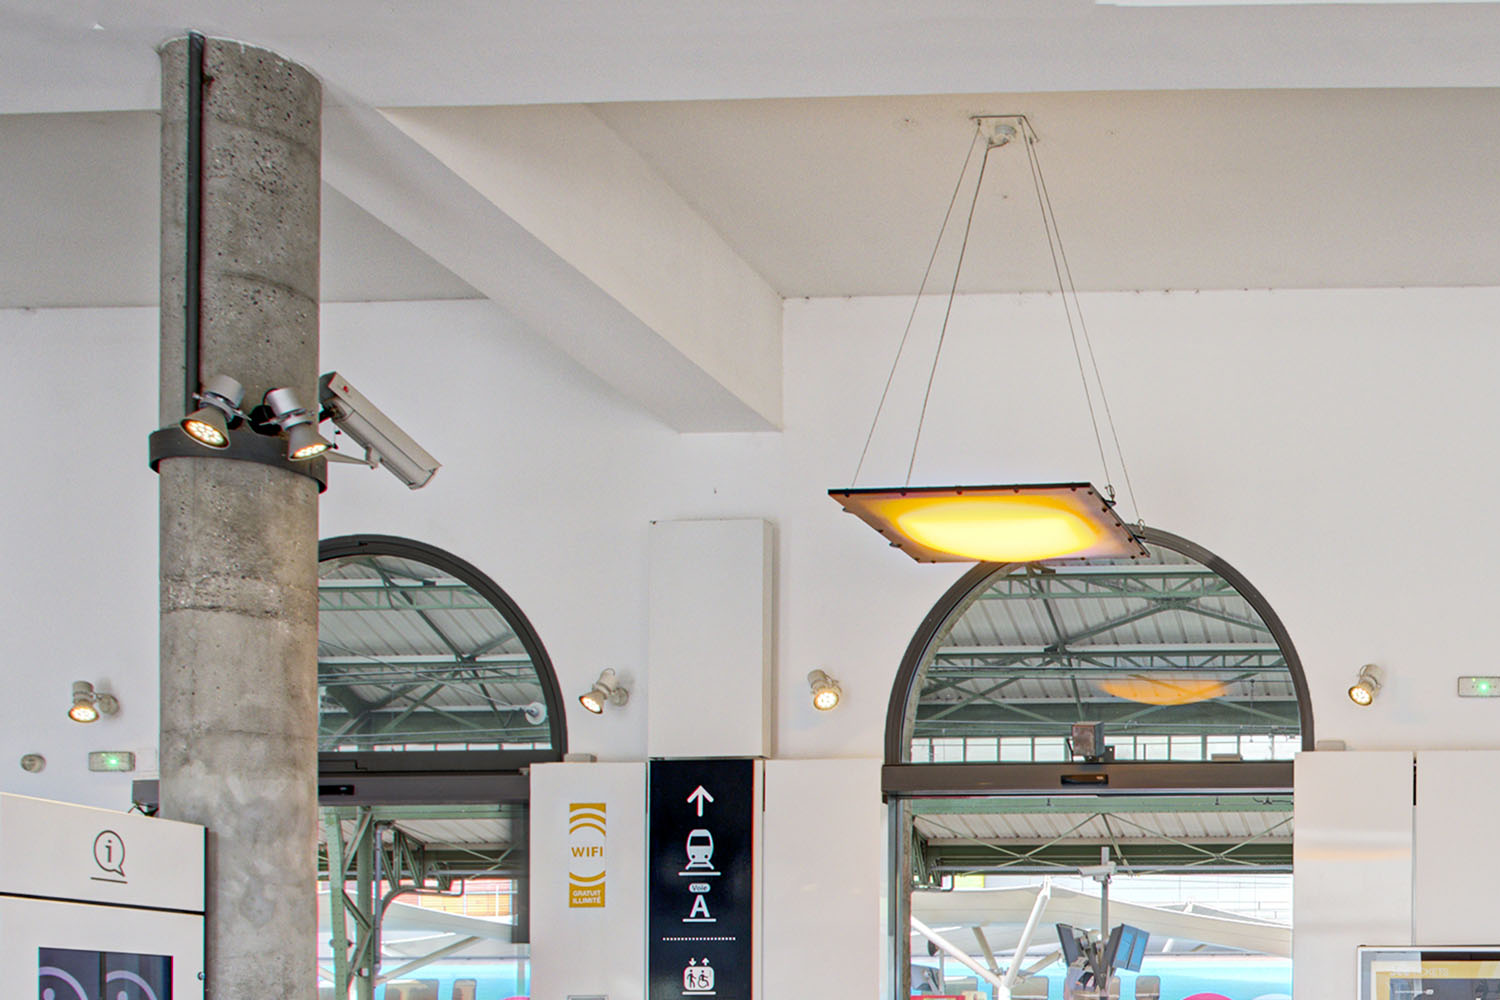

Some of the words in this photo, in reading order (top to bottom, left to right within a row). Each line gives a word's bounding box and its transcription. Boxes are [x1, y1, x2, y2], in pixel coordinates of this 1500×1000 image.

[571, 846, 604, 857] WIFI
[691, 884, 709, 892] Voie
[572, 889, 601, 897] GRATUIT
[572, 896, 601, 904] ILLIMITÉ
[689, 895, 711, 918] A
